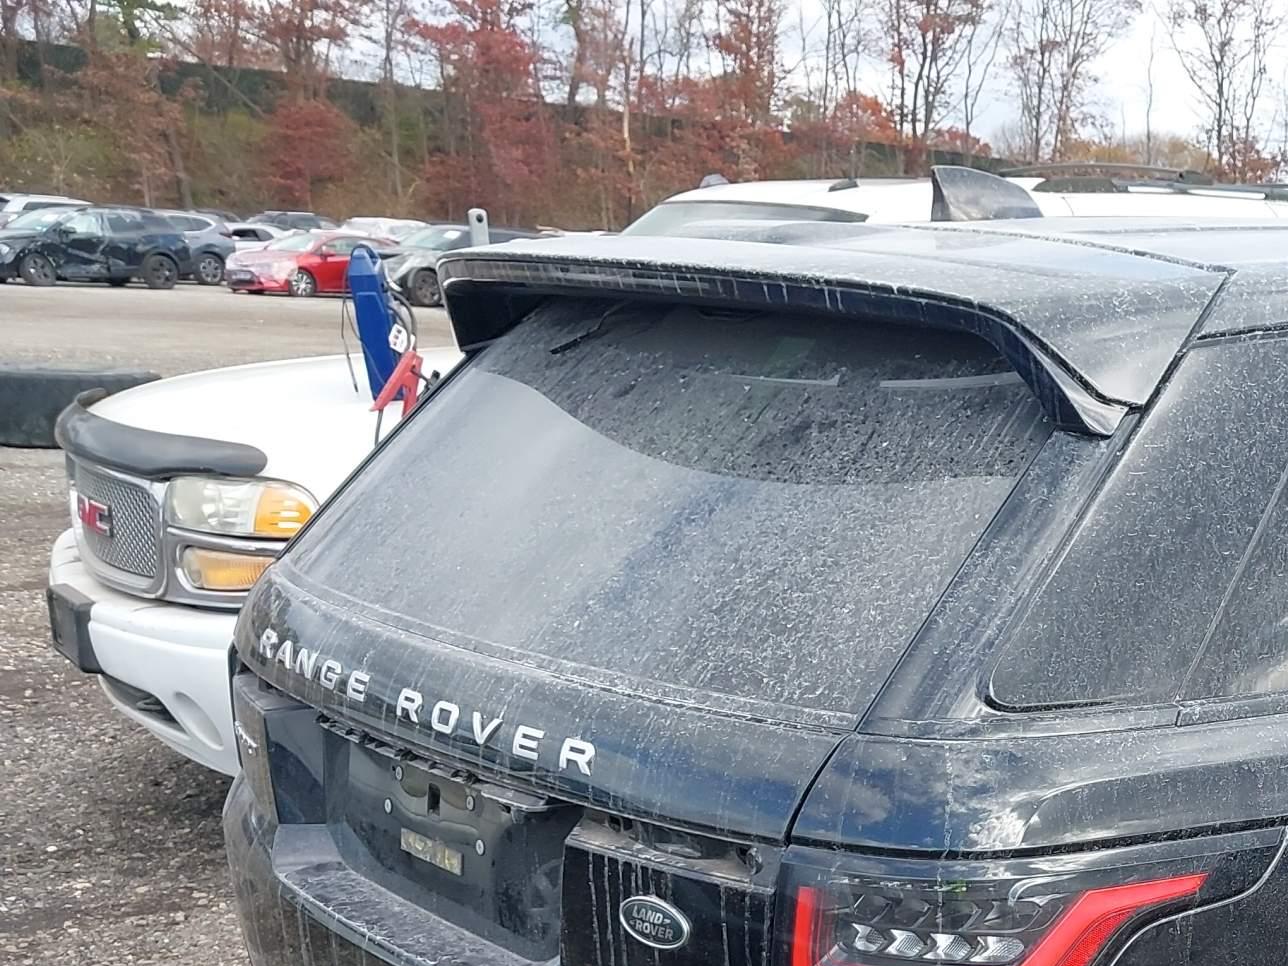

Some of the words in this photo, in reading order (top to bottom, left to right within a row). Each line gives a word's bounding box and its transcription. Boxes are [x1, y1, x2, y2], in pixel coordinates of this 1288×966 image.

[78, 493, 111, 537] MC
[260, 628, 371, 702] RANGE
[396, 688, 597, 776] ROVER
[632, 904, 666, 925] LAND
[634, 920, 674, 940] ROVER
